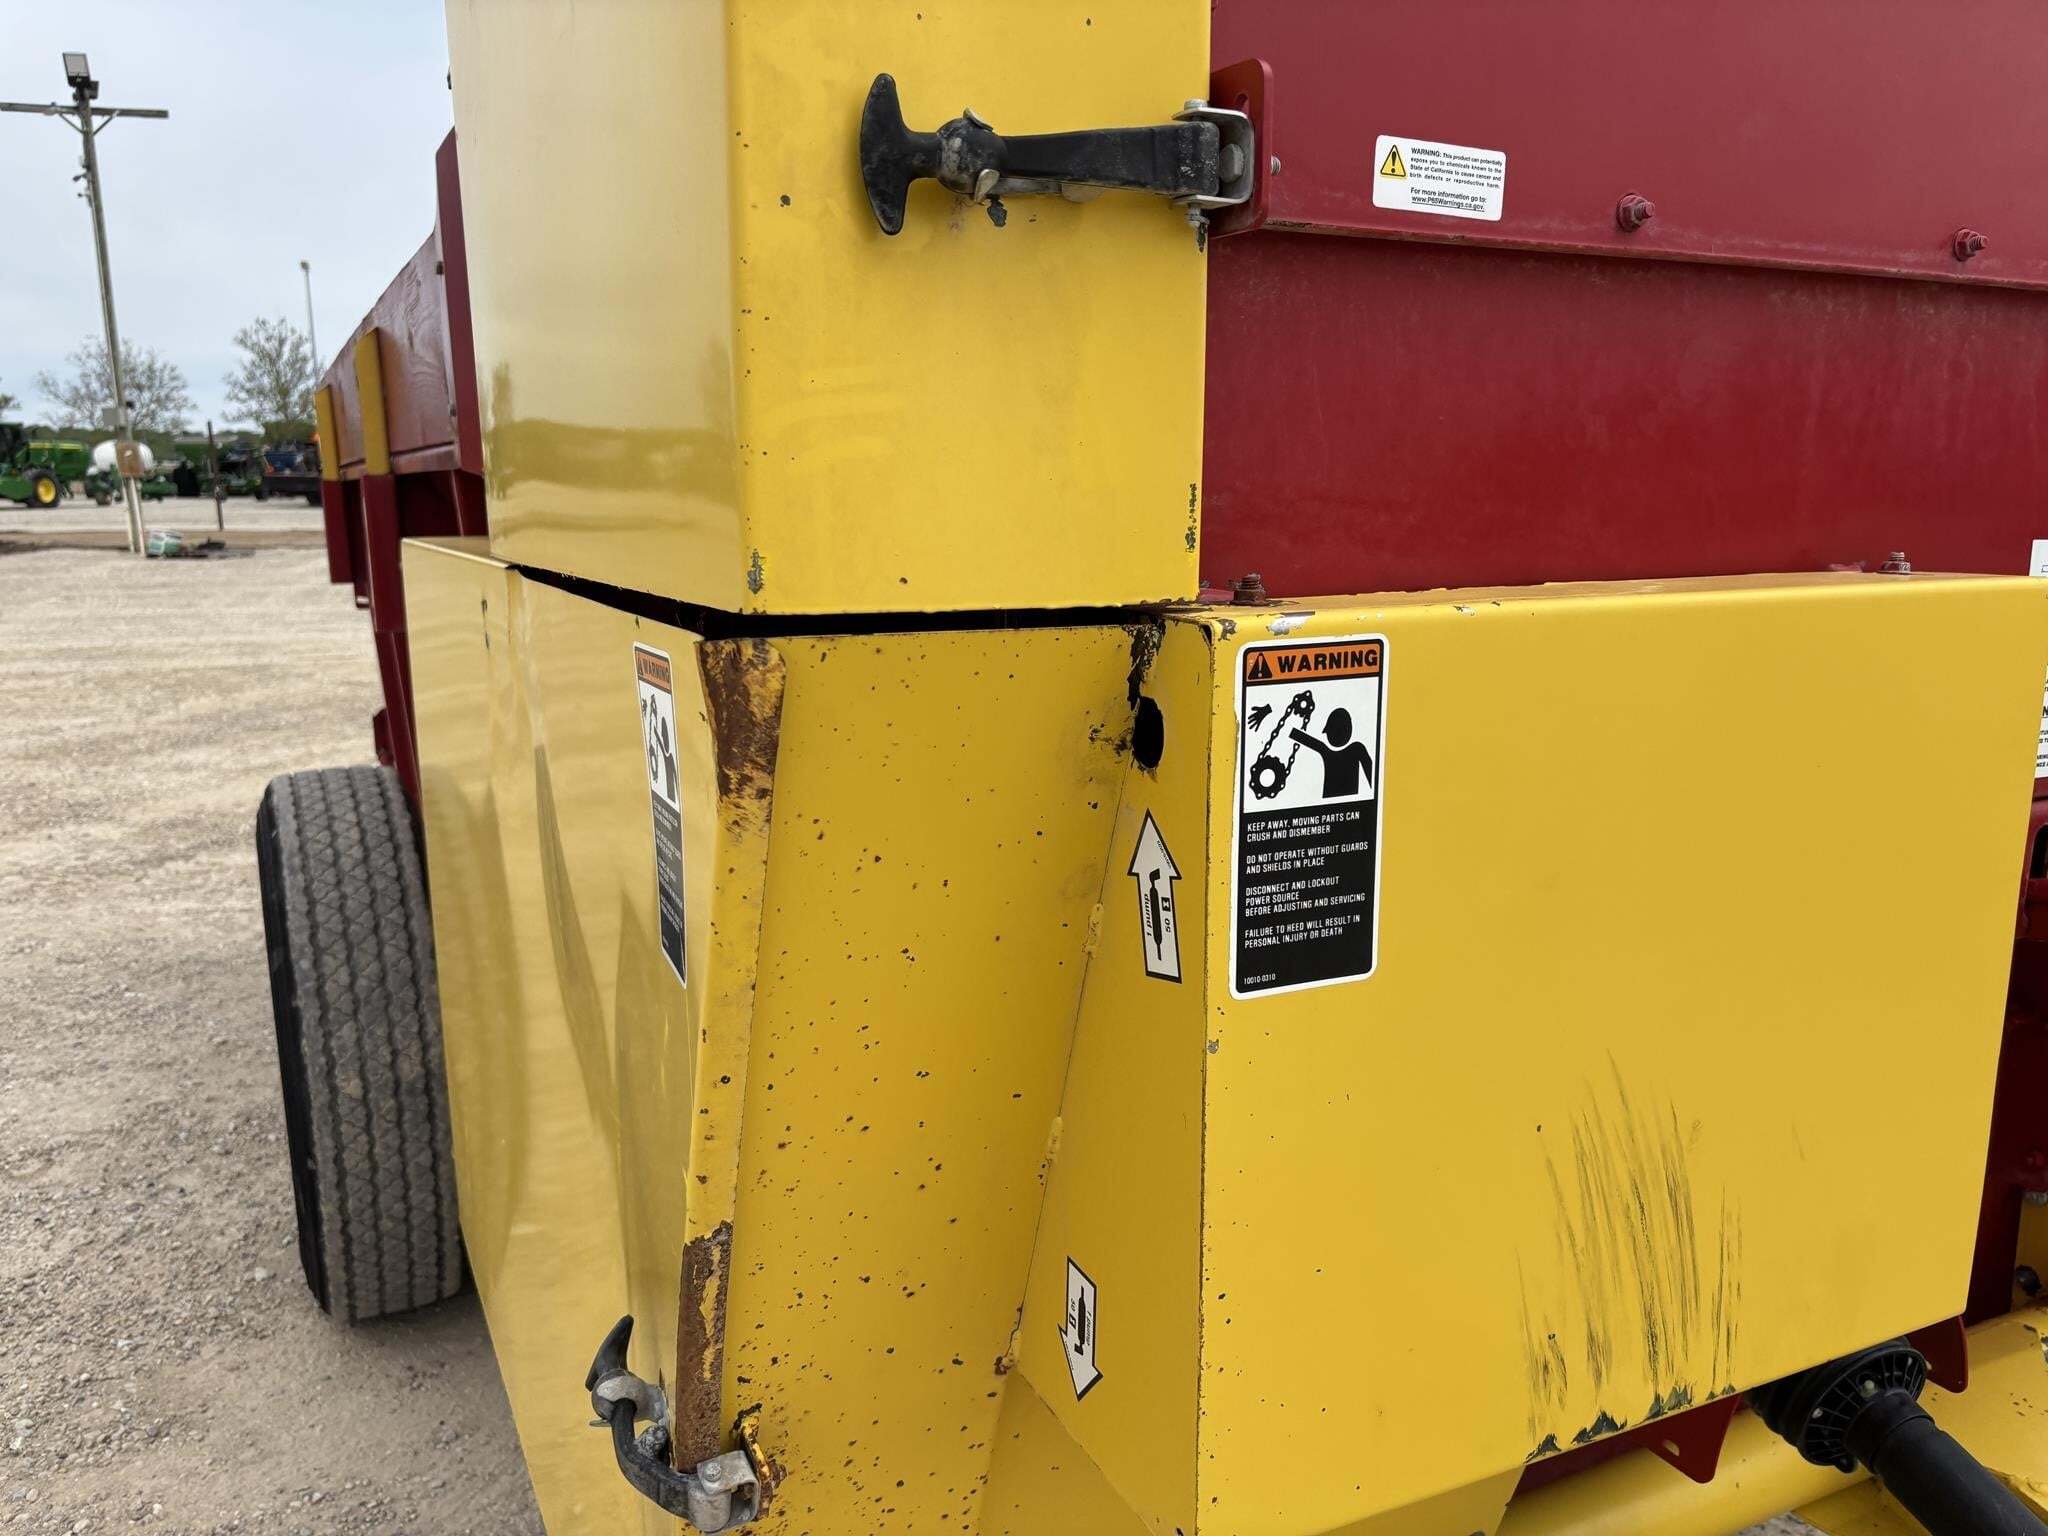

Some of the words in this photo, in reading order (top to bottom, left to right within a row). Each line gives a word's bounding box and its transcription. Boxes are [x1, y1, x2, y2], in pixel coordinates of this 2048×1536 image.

[1411, 147, 1441, 158] WARNING:
[1431, 166, 1454, 175] California
[1446, 161, 1470, 170] chemicals
[1454, 178, 1485, 187] reproductive
[1411, 187, 1421, 195] For
[1422, 189, 1437, 197] more
[1438, 191, 1470, 201] information
[1277, 649, 1378, 673] WARNING
[1247, 821, 1266, 832] KEEP
[1292, 815, 1320, 827] MOVING
[1321, 812, 1344, 822] PARTS
[1345, 811, 1360, 821] CAN
[1246, 830, 1271, 843] CRUSH
[1272, 829, 1287, 839] AND
[1288, 824, 1331, 838] DISMEMBER
[1246, 854, 1256, 864] DO
[1258, 852, 1272, 863] NOT
[1274, 848, 1306, 861] OPERATE
[1307, 844, 1340, 857] WITHOUT
[1341, 841, 1369, 853] GUARDS
[1246, 864, 1261, 875] AND
[1262, 860, 1292, 873] SHIELDS
[1293, 859, 1301, 869] IN
[1303, 856, 1325, 867] PLACE
[1245, 882, 1290, 897] DISCONNECT
[1291, 880, 1306, 891] AND
[1307, 875, 1340, 888] LOCKOUT
[1245, 895, 1271, 907] POWER
[1272, 891, 1300, 903] SOURCE
[1245, 905, 1271, 917] BEFORE
[1273, 899, 1313, 913] ADJUSTING
[1314, 897, 1329, 908] AND
[1330, 892, 1366, 905] SERVICING
[1144, 893, 1153, 929] pump
[1164, 918, 1171, 933] 50
[1244, 926, 1274, 938] FAILURE
[1276, 924, 1285, 934] TO
[1286, 921, 1304, 933] HEED
[1306, 918, 1323, 930] WILL
[1325, 915, 1351, 927] RESULT
[1353, 914, 1361, 923] IN
[1244, 936, 1281, 949] PERSONAL
[1282, 931, 1308, 943] INJURY
[1309, 929, 1319, 939] OR
[1321, 926, 1343, 938] DEATH
